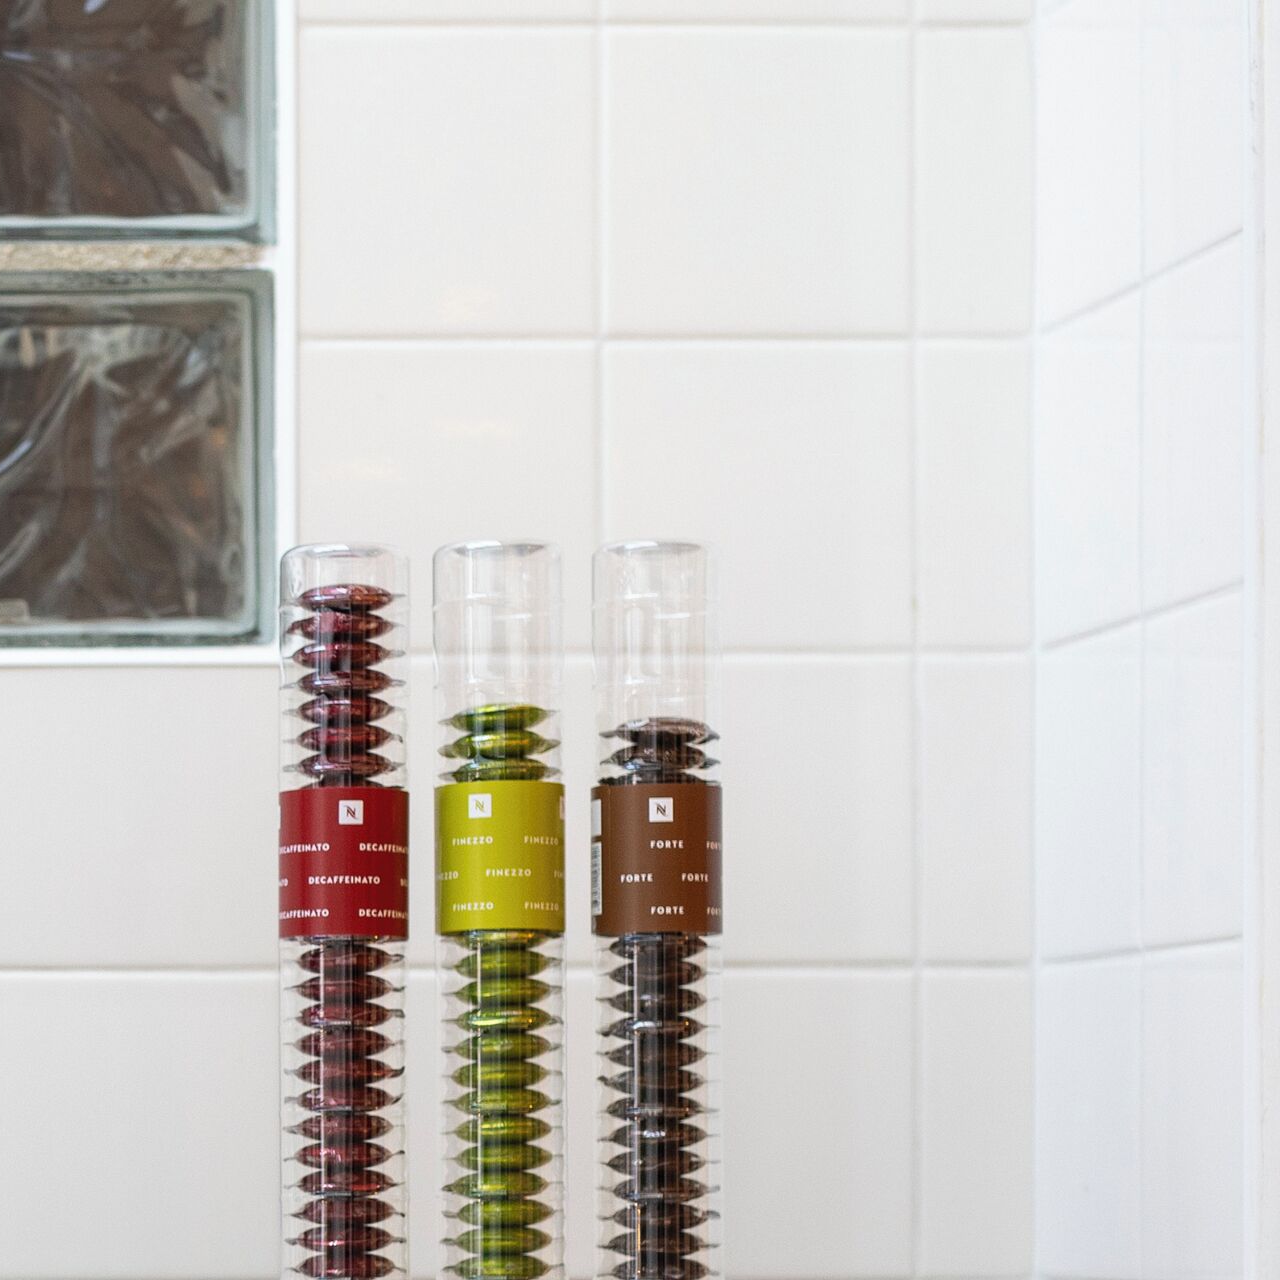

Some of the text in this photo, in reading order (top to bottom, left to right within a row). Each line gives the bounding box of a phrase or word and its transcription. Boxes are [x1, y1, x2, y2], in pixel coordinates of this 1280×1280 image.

[452, 836, 559, 846] FINEZZO FINEZZO
[650, 840, 684, 849] FORTE
[486, 868, 532, 877] FINEZZO
[308, 876, 381, 885] DECAFFEINATO
[620, 873, 709, 883] FORTE FORTE
[452, 902, 560, 912] FINEZZO FINEZZO
[650, 906, 684, 915] FORTE
